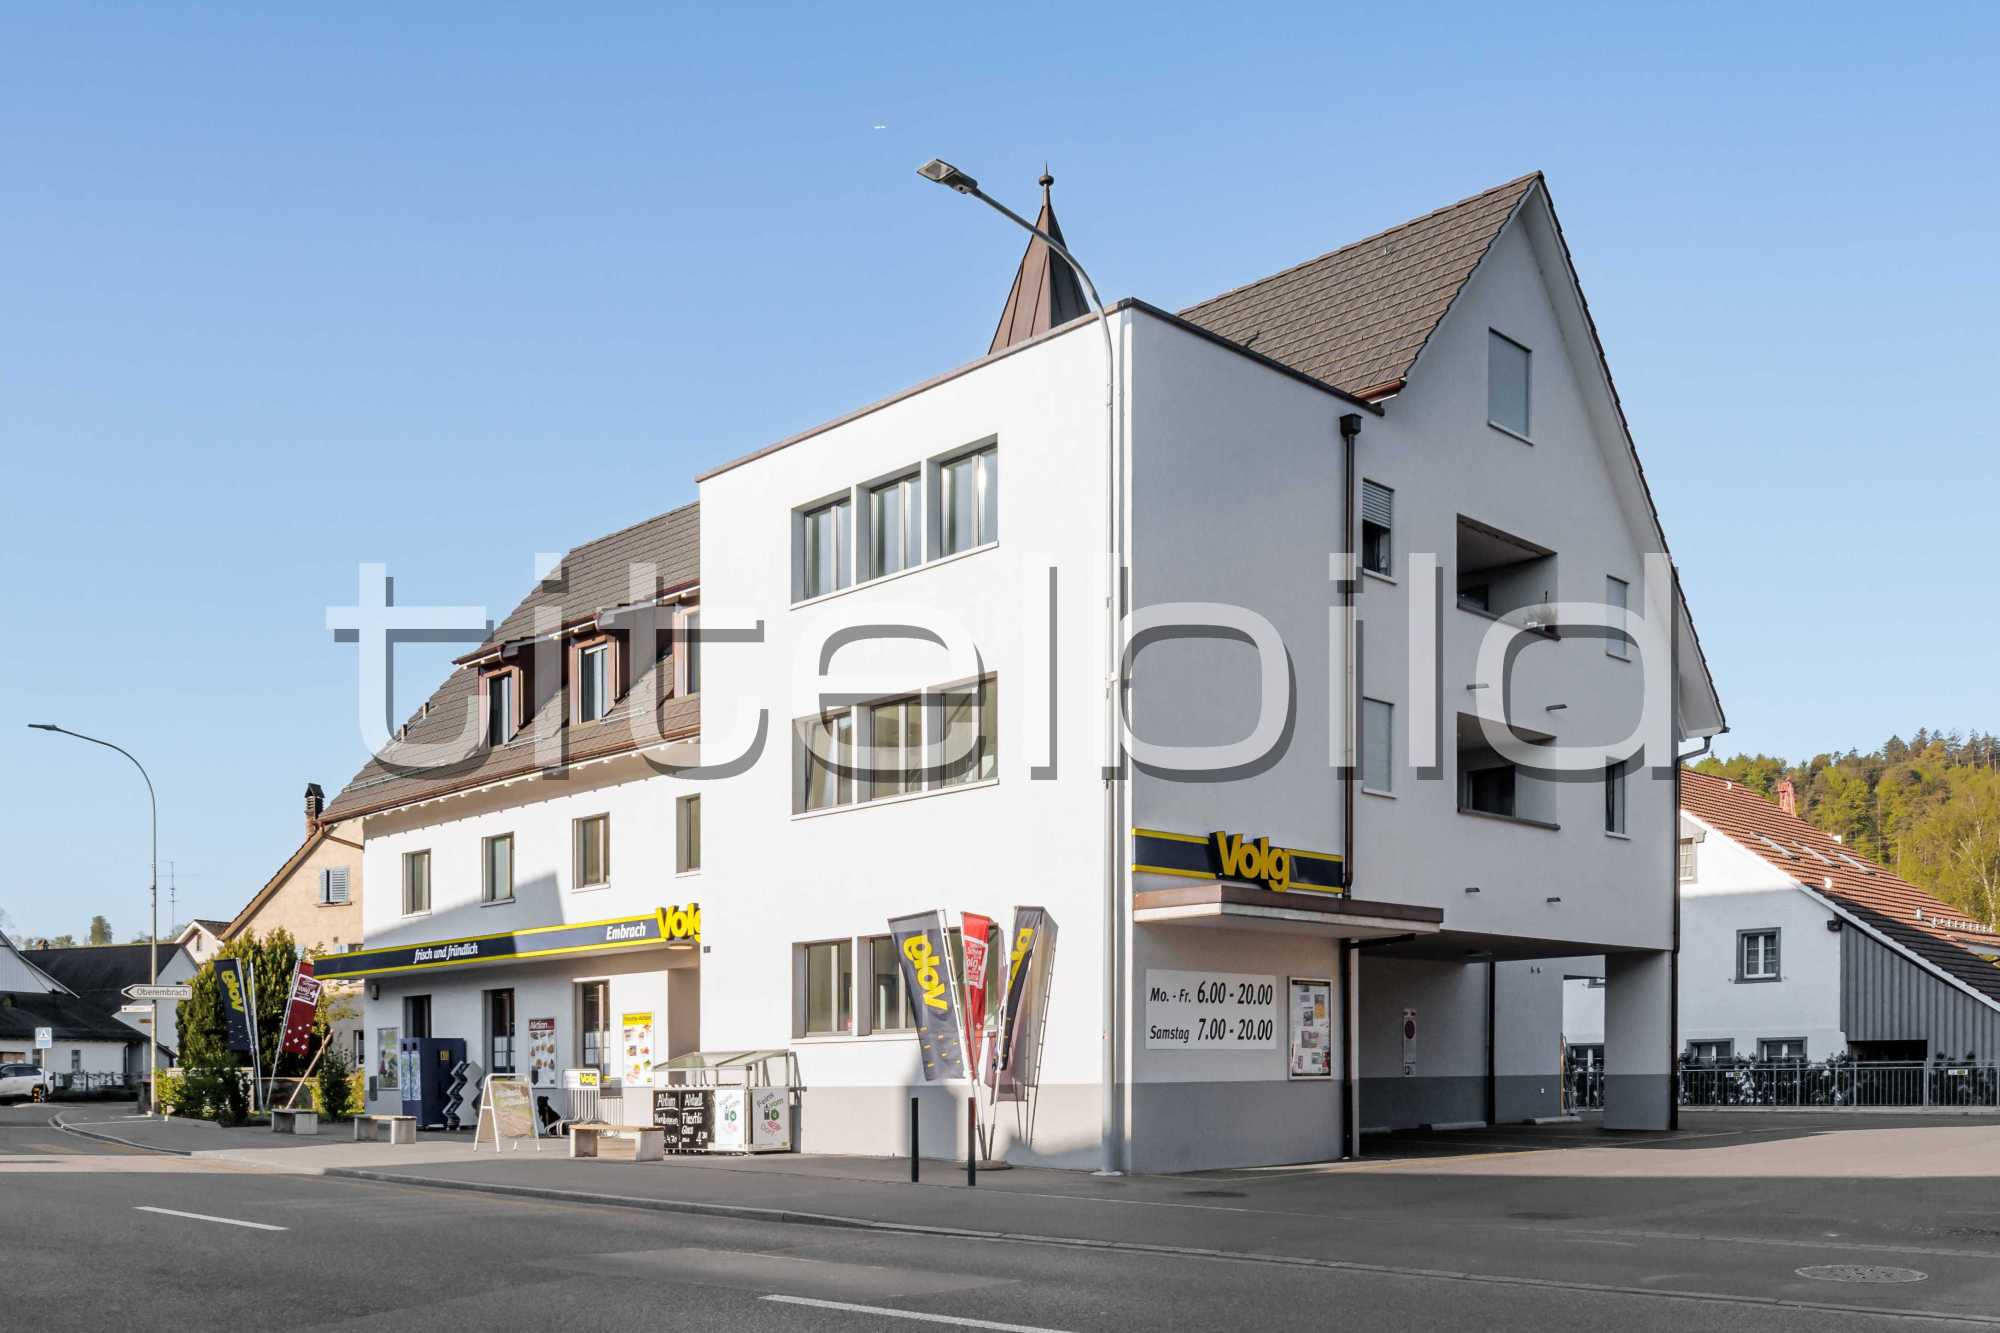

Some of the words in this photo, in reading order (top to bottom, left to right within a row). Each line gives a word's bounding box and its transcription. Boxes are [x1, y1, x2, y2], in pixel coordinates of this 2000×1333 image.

[1211, 831, 1291, 893] Volg
[606, 923, 646, 941] Embrach
[413, 947, 433, 964] frisch
[433, 946, 447, 959] und
[1150, 987, 1169, 1002] Mo.
[1179, 988, 1191, 1003] Fr.
[1197, 981, 1226, 1004] 6.00
[1237, 983, 1273, 1005] 20.00
[1150, 1025, 1190, 1044] Samstag
[1197, 1018, 1226, 1041] 7.00
[1237, 1018, 1273, 1041] 20.00
[579, 1073, 597, 1086] Volg
